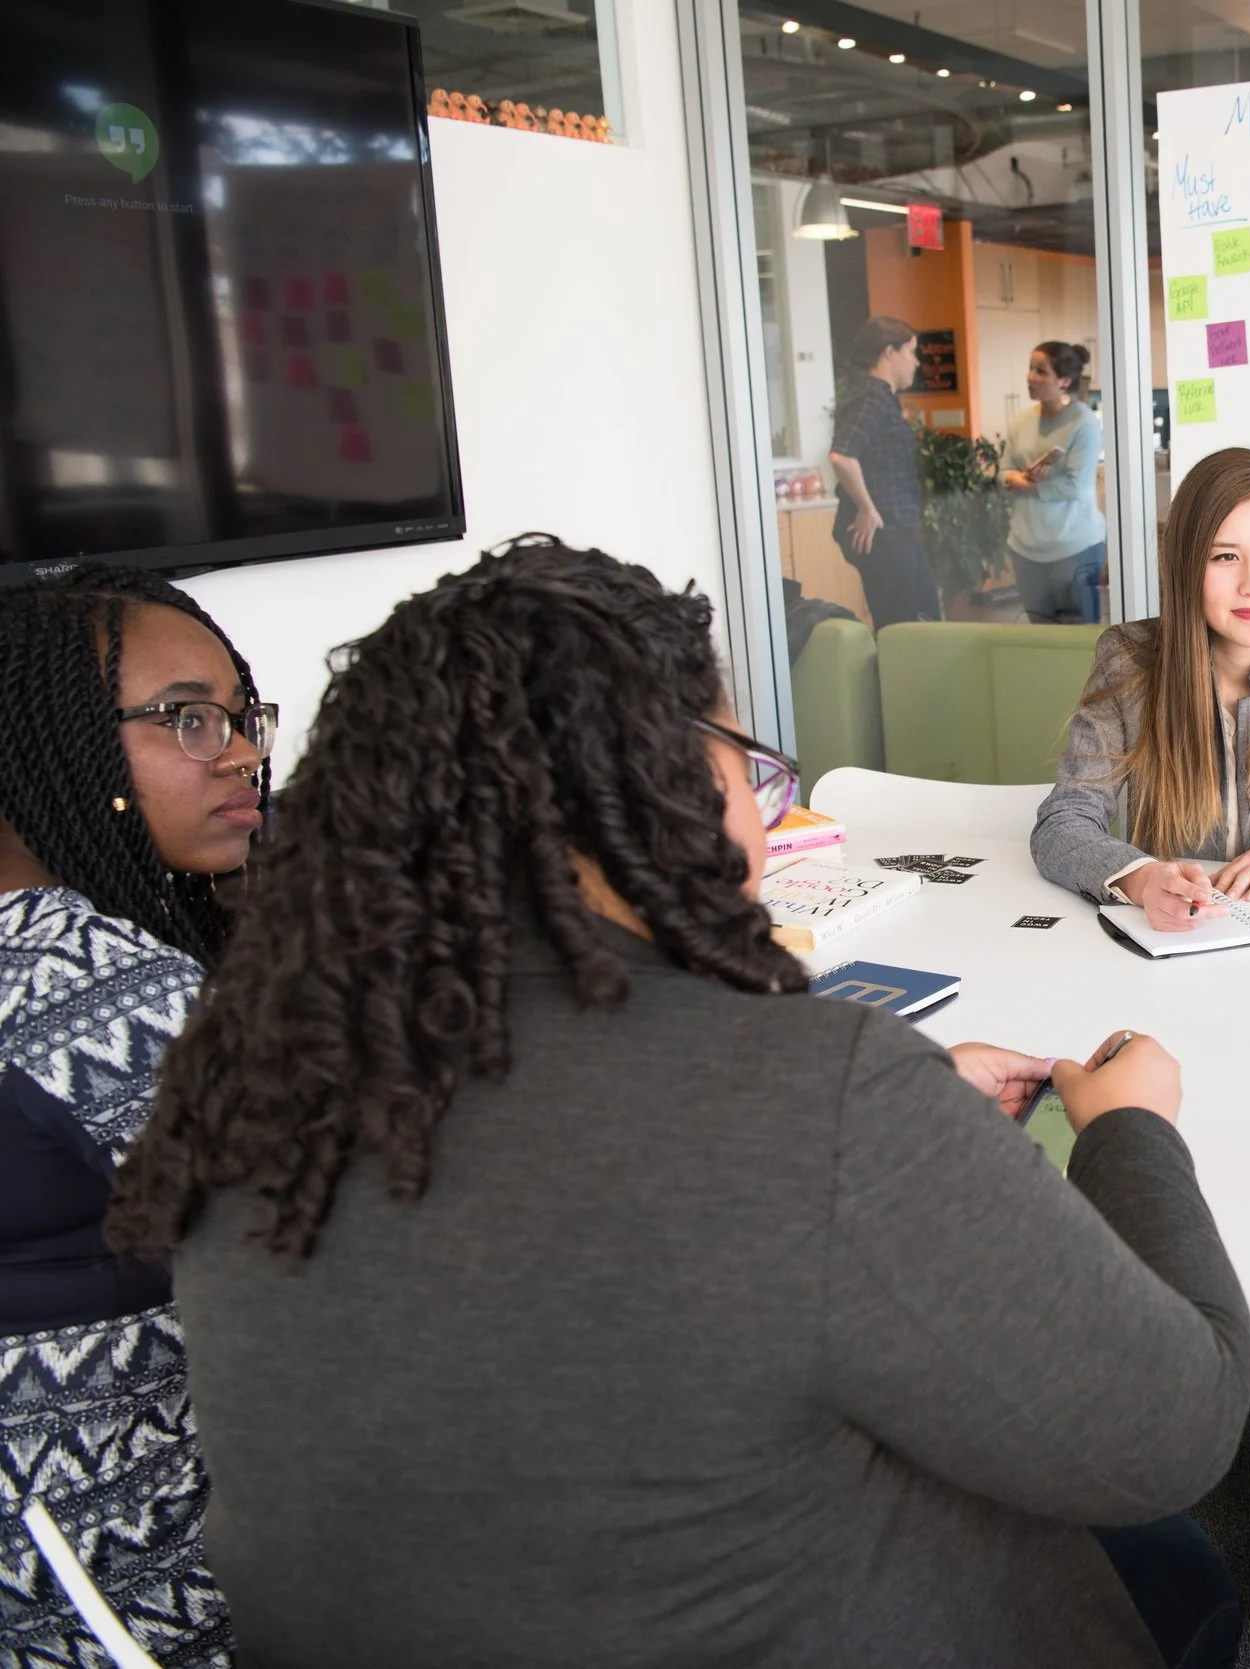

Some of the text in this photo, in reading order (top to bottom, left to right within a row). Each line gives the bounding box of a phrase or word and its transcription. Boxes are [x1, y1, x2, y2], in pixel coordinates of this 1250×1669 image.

[1172, 151, 1218, 201] Must
[64, 193, 98, 207] Press
[99, 198, 119, 212] any
[120, 197, 156, 212] button
[157, 201, 168, 213] to
[1188, 194, 1232, 220] Have
[775, 878, 869, 900] Google
